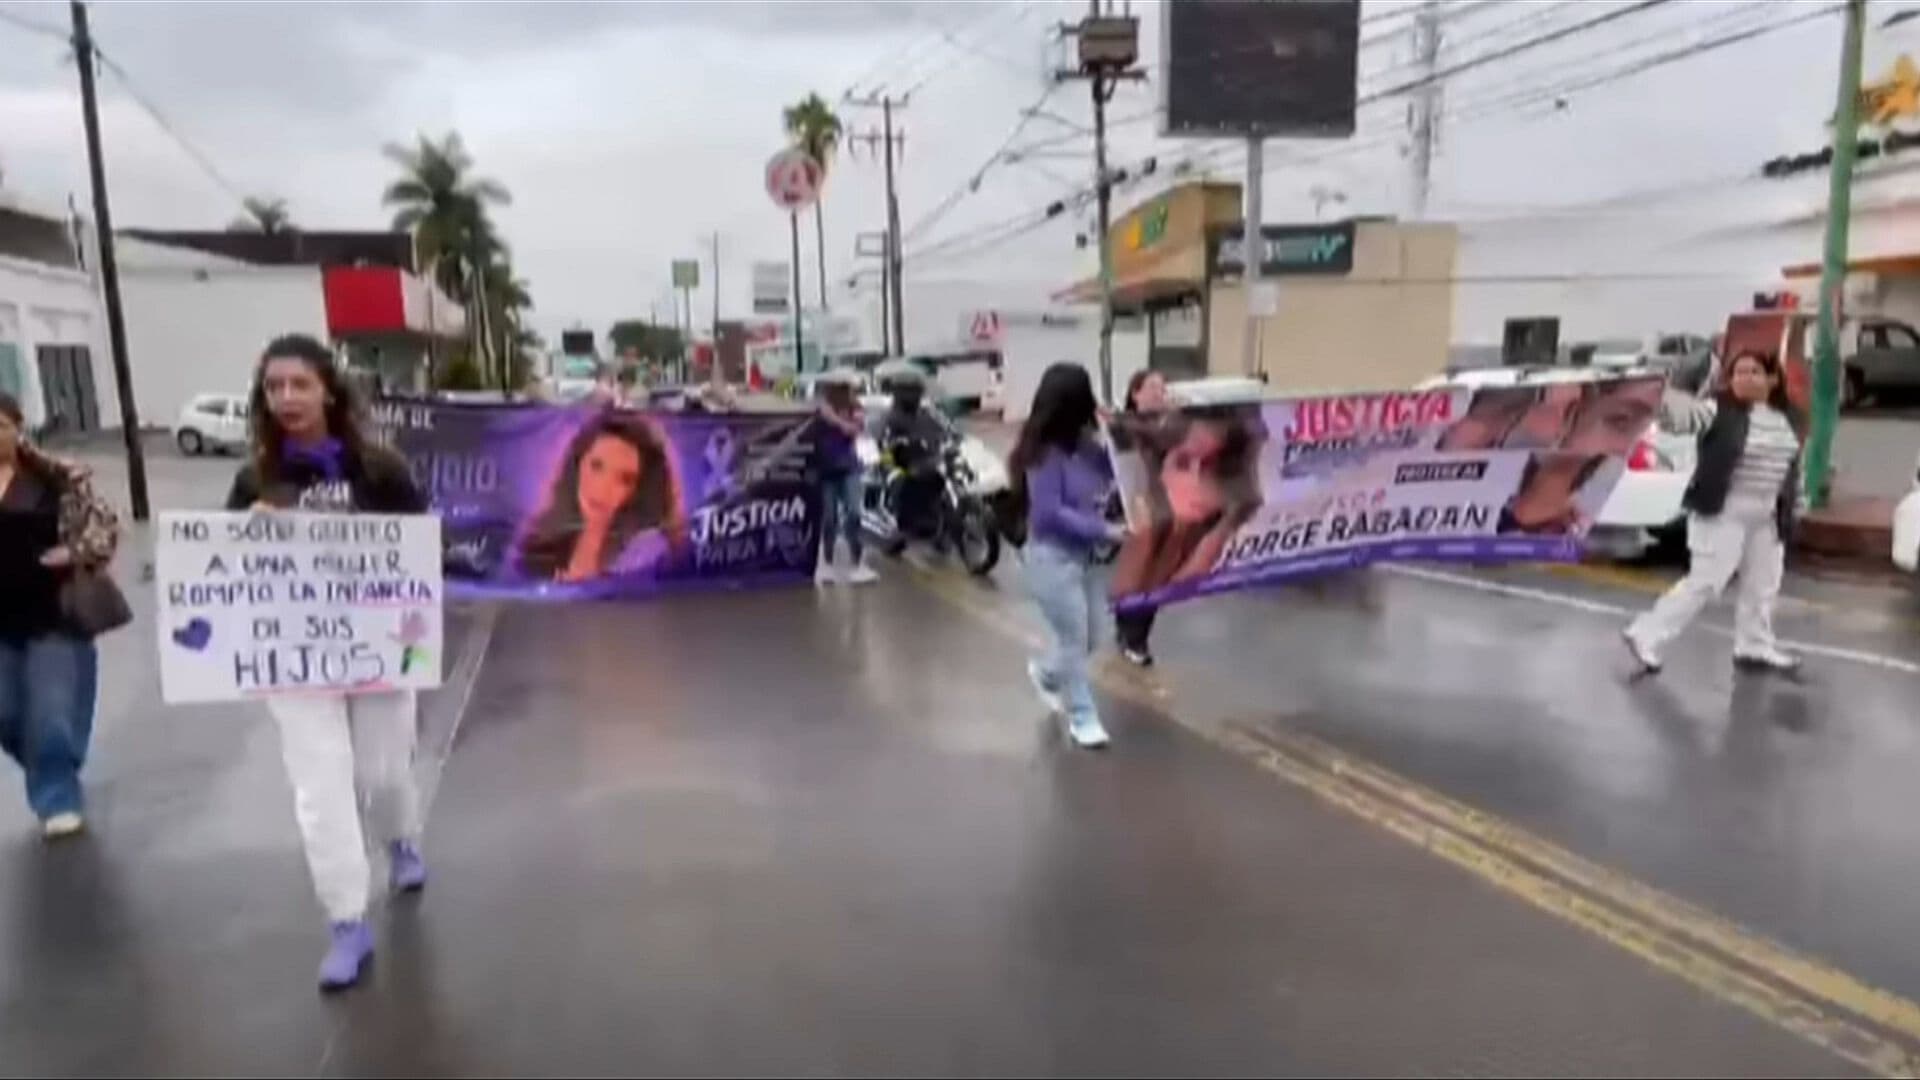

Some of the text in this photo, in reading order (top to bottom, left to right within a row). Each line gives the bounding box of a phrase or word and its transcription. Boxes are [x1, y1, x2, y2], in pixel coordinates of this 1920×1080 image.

[1284, 390, 1453, 441] JUSTICIA
[171, 520, 209, 541] NO
[690, 495, 806, 543] JUSTICIA
[205, 553, 228, 576] A
[243, 554, 298, 576] UNA
[289, 580, 317, 600] LA
[305, 615, 354, 641] SUS
[234, 640, 385, 688] HIJOS
